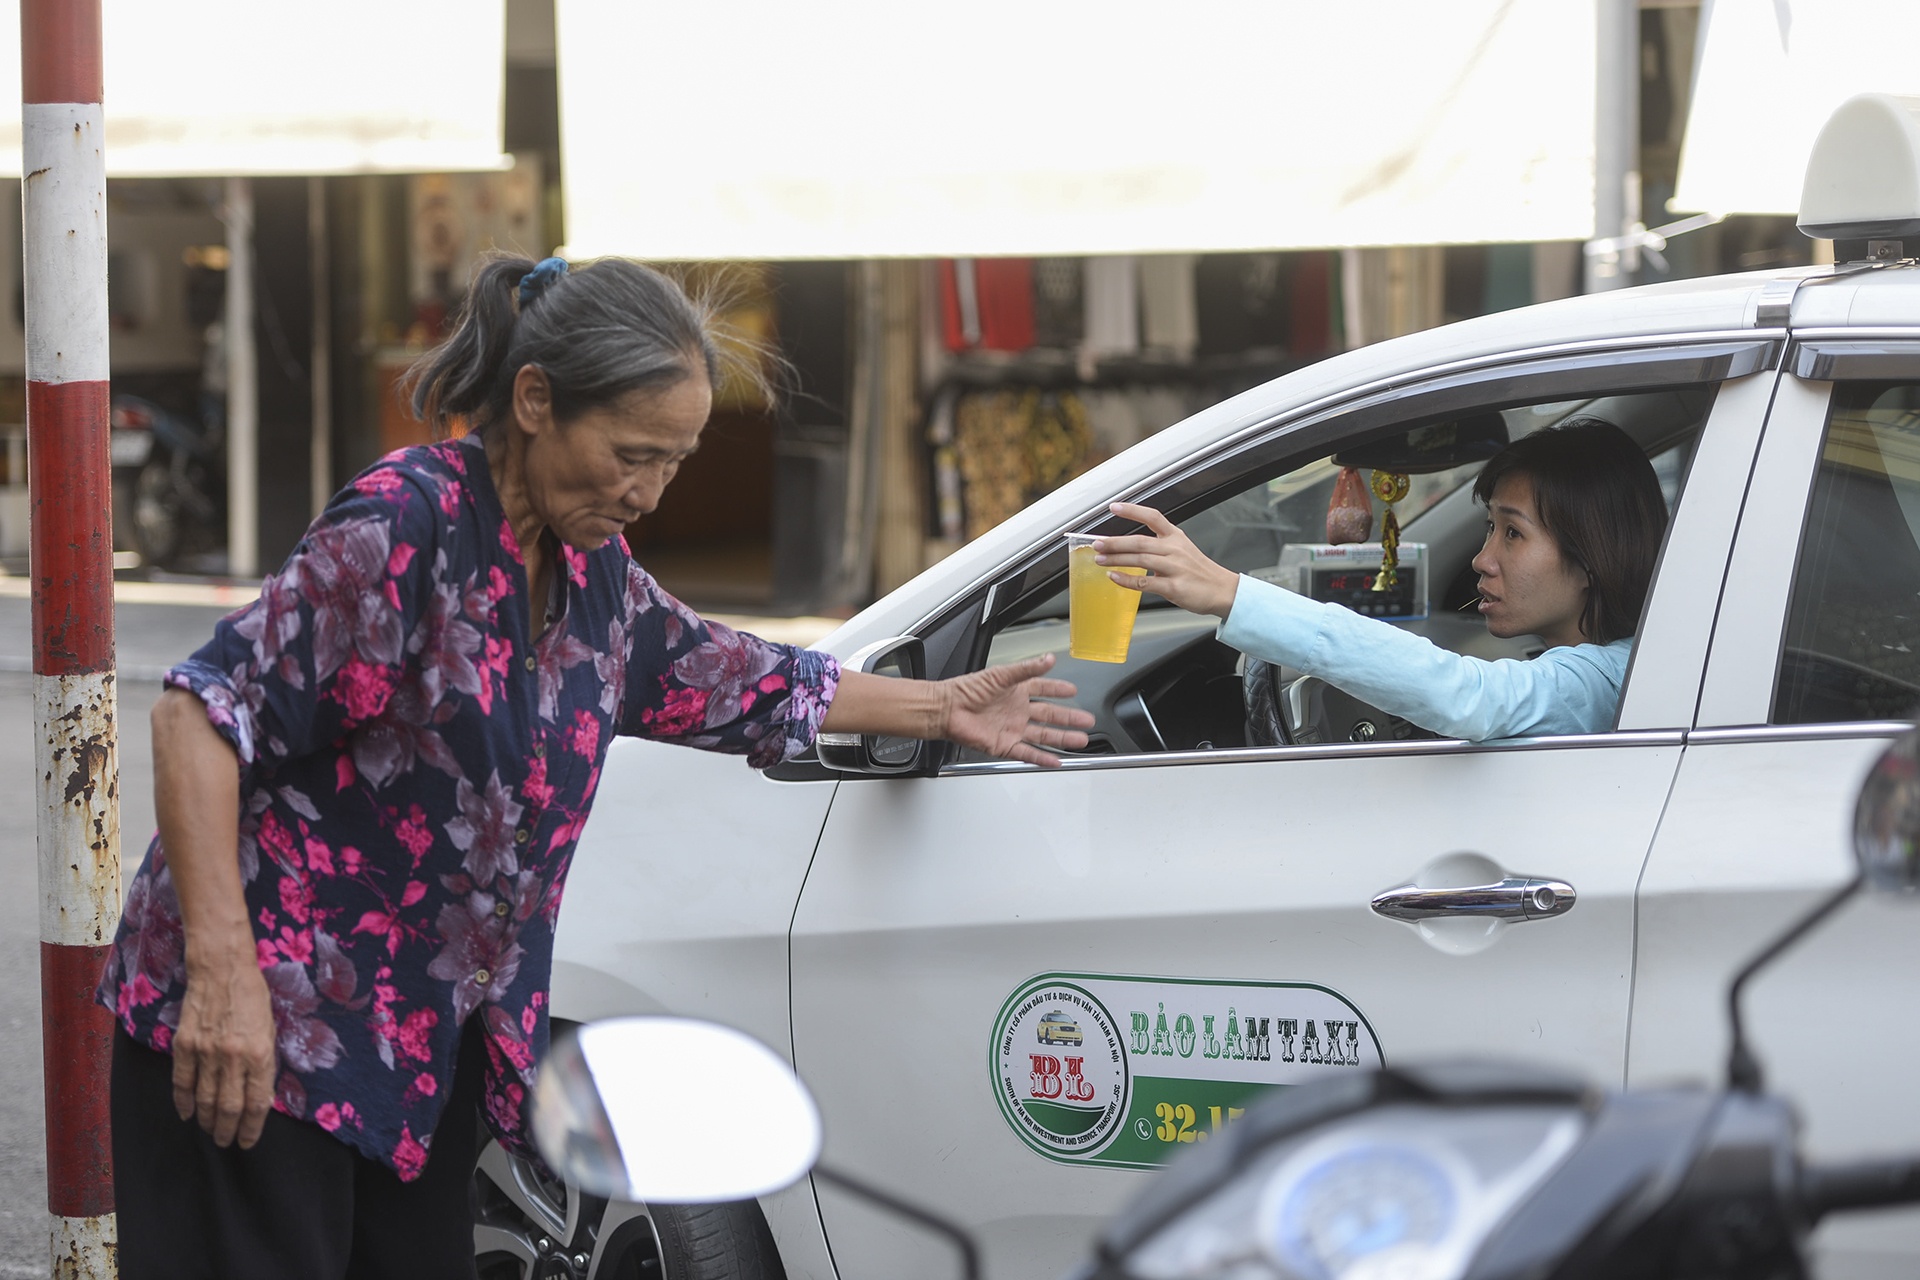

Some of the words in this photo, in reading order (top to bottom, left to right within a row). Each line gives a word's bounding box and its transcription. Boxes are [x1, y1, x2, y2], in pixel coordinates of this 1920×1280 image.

[1003, 1035, 1013, 1056] CÔNG
[1008, 1026, 1016, 1036] TY
[1044, 992, 1052, 1002] TƯ
[1058, 992, 1073, 1003] DỊCH
[1073, 995, 1082, 1007] VỤ
[1091, 1009, 1102, 1023] TẢI
[1099, 1020, 1111, 1038] NAM
[1111, 1049, 1120, 1063] NỘI
[1130, 1002, 1197, 1059] BẢO
[1202, 1007, 1271, 1062] LÂM
[1277, 1018, 1361, 1067] TAXI
[1004, 1076, 1016, 1099] SOUTH
[1029, 1053, 1095, 1101] BL
[1012, 1098, 1021, 1108] OF
[1016, 1106, 1026, 1118] HA
[1023, 1114, 1034, 1127] NOI
[1096, 1100, 1118, 1134] TRANSPORT
[1032, 1124, 1065, 1145] INVESTMENT
[1065, 1137, 1078, 1146] AND
[1077, 1128, 1099, 1145] SERVICE
